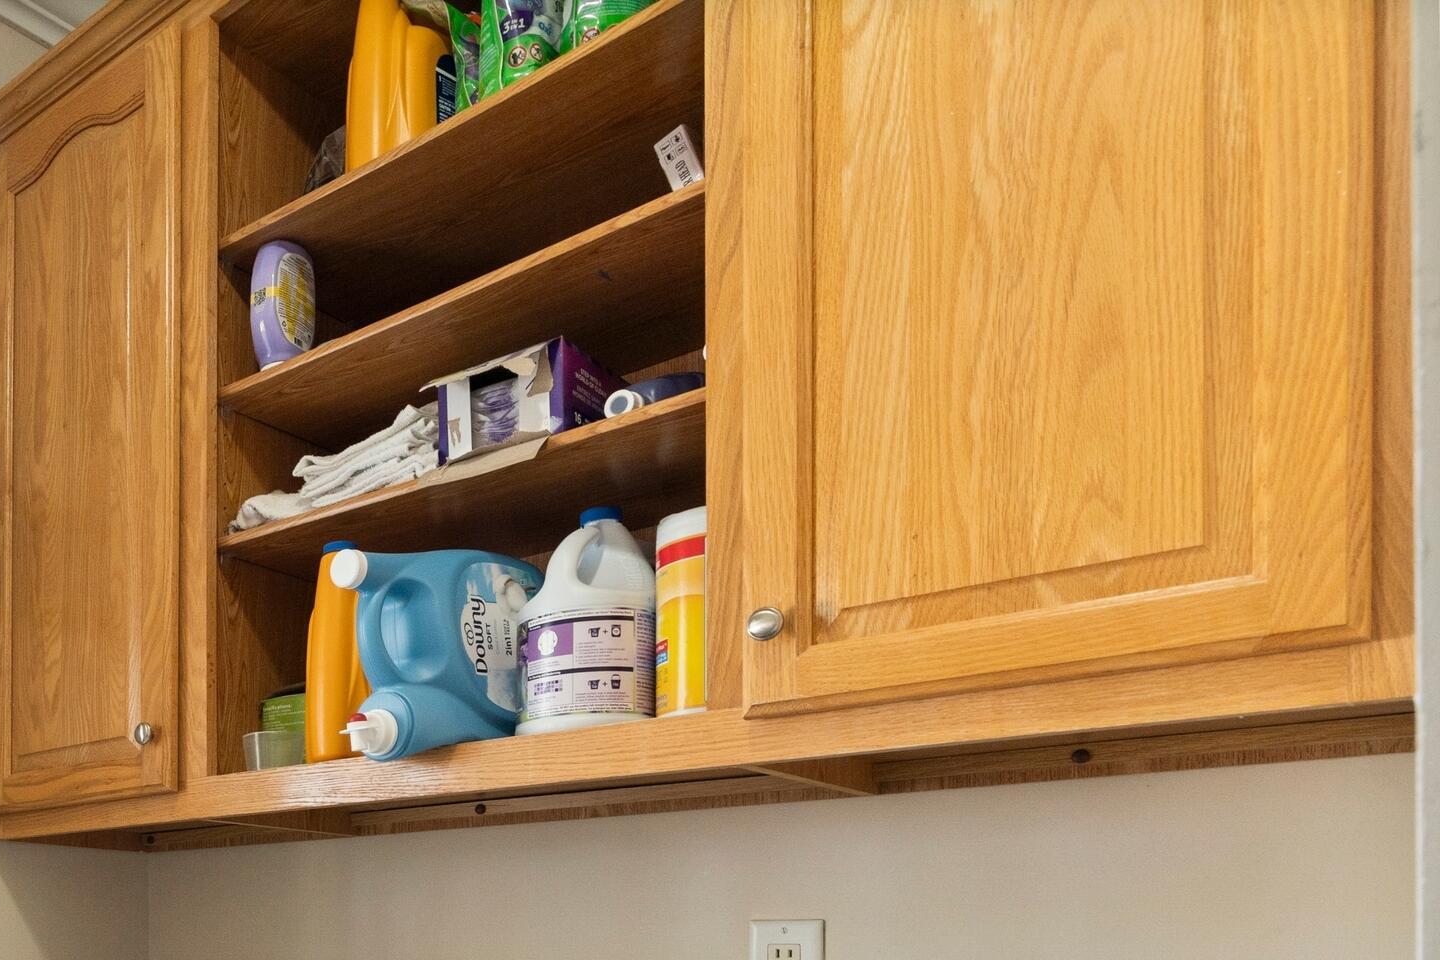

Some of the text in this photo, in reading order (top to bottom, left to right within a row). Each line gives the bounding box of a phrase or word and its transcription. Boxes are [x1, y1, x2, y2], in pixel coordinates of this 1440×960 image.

[502, 21, 511, 35] 3
[518, 18, 526, 29] 1
[675, 160, 691, 182] HEAD
[470, 596, 489, 674] Downy
[485, 623, 494, 651] SOFT
